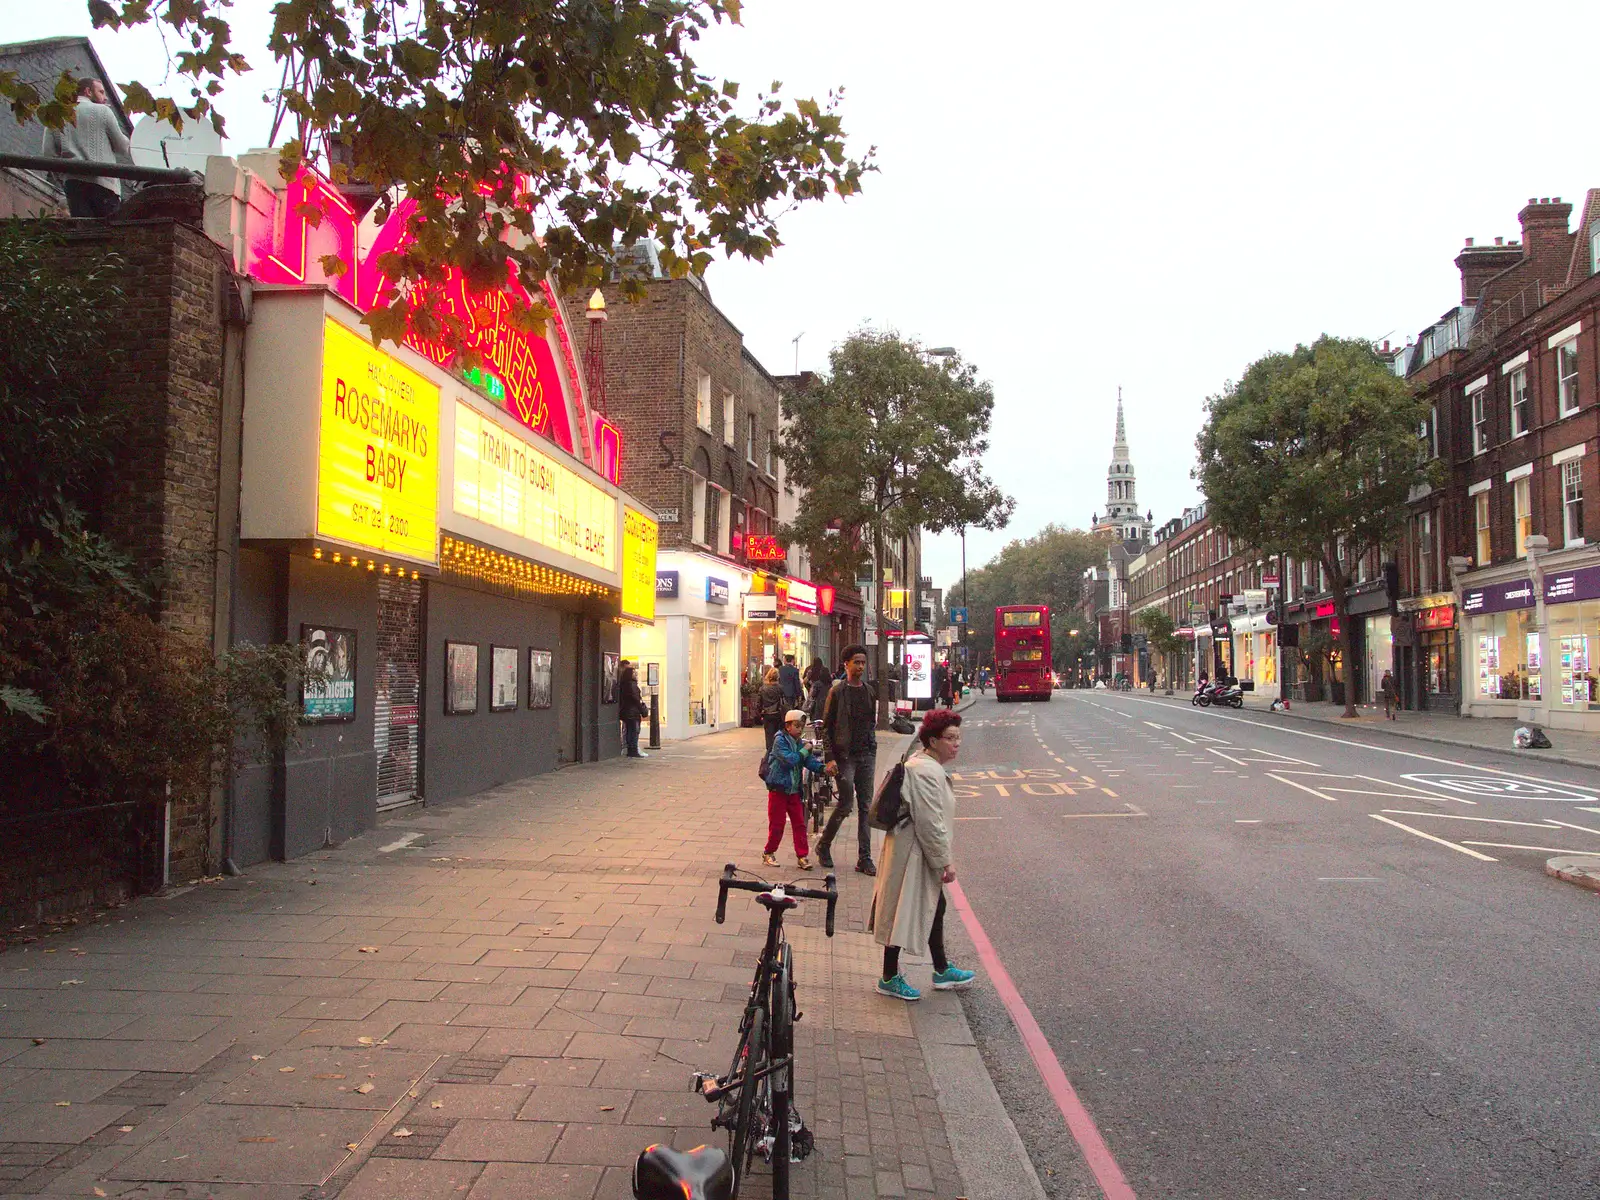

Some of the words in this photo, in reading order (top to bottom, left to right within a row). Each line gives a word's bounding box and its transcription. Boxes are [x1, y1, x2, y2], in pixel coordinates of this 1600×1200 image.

[367, 361, 415, 404] HALLOWEEN
[335, 377, 428, 457] ROSEMARYS
[366, 444, 407, 493] BABY
[482, 429, 511, 473] TRAIN
[513, 448, 526, 480] TO
[529, 458, 556, 496] BUSAN
[352, 503, 369, 525] SAT
[389, 514, 409, 538] 2300
[558, 514, 582, 549] DANIEL
[585, 527, 605, 558] BLAKE
[325, 680, 354, 699] NIGHTS
[951, 769, 1062, 780] BUS
[952, 782, 1098, 798] STOP
